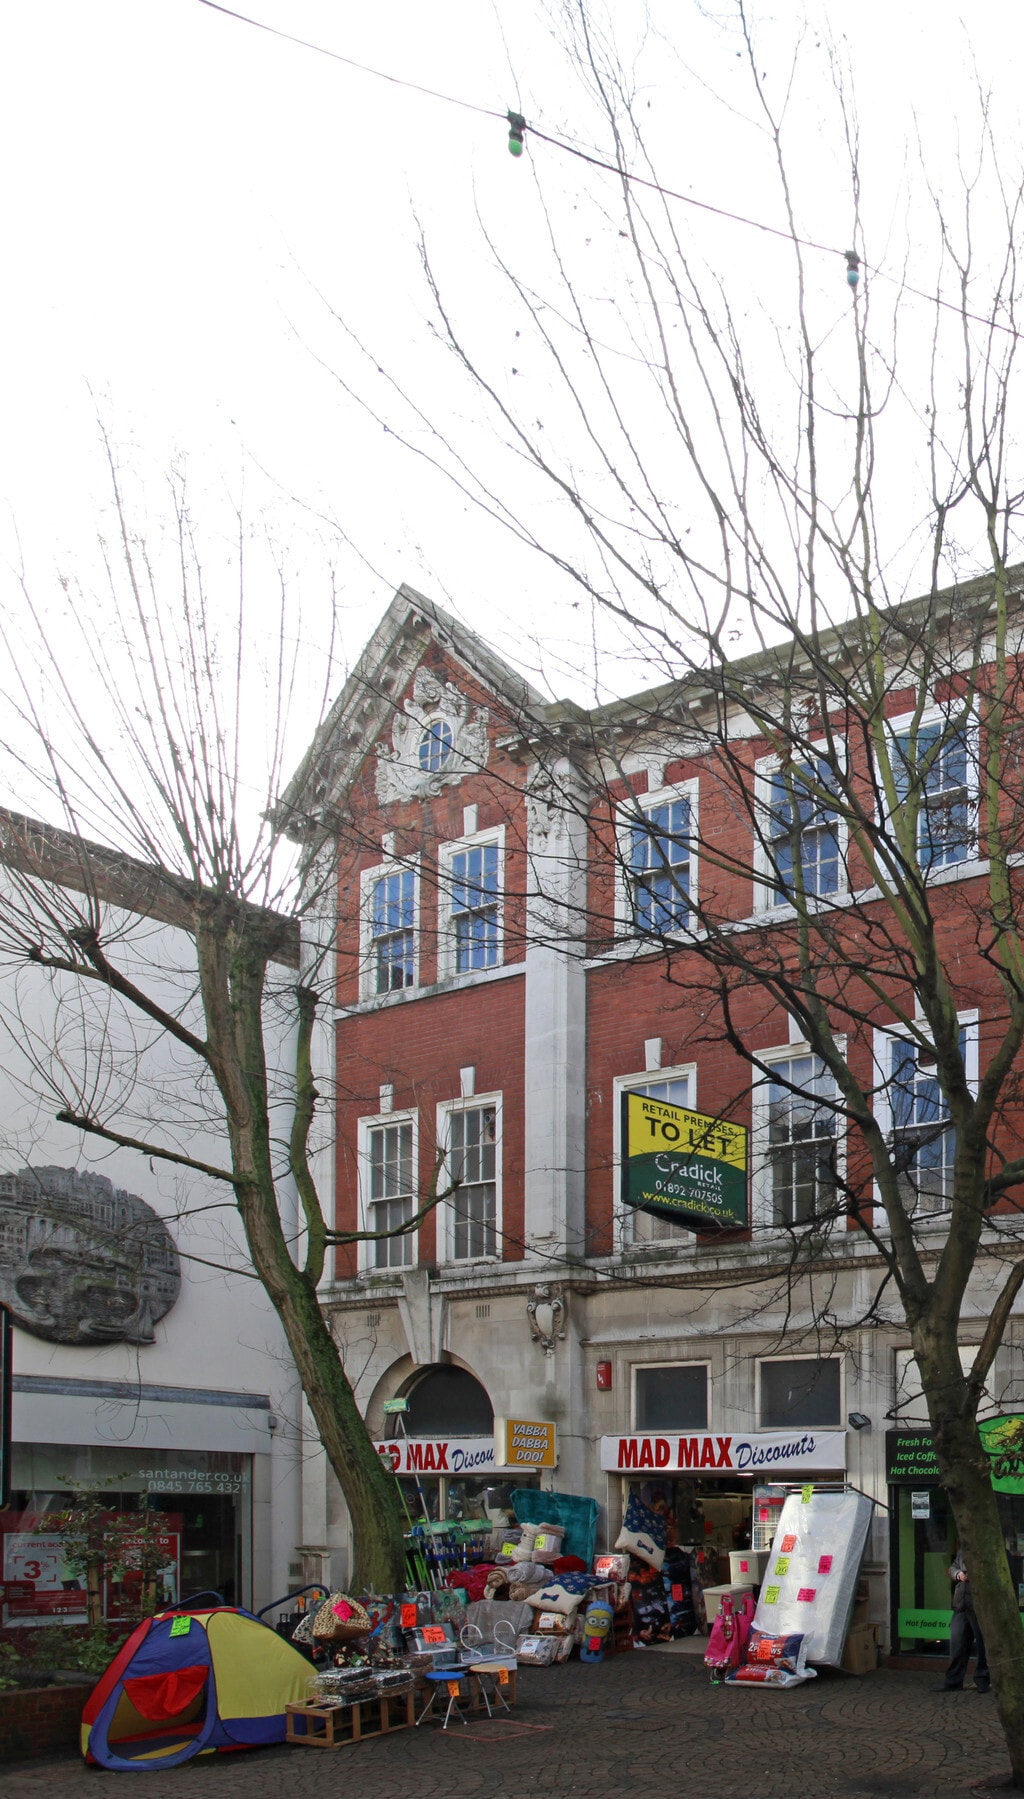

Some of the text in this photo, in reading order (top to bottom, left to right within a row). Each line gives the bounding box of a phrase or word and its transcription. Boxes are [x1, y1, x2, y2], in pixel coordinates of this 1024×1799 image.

[642, 1103, 734, 1136] RETAIL PREMISES
[645, 1116, 732, 1155] TO LET
[655, 1154, 723, 1185] Cradick
[656, 1180, 723, 1204] 01892 707505
[642, 1192, 734, 1218] www.cradick.co.uk
[513, 1424, 548, 1437] YABBA
[512, 1438, 548, 1450] DABBA
[897, 1438, 932, 1447] Fresh Fo
[406, 1443, 449, 1470] MAX
[452, 1448, 494, 1472] Discou
[516, 1452, 544, 1462] DOO!
[618, 1434, 816, 1469] MAD MAX Discounts
[897, 1452, 937, 1462] Iced Coffe
[139, 1469, 250, 1484] santander.co.uk
[890, 1467, 906, 1475] Hot
[148, 1481, 248, 1494] 0845 765 4321
[12, 1541, 46, 1549] current
[920, 1620, 938, 1628] food
